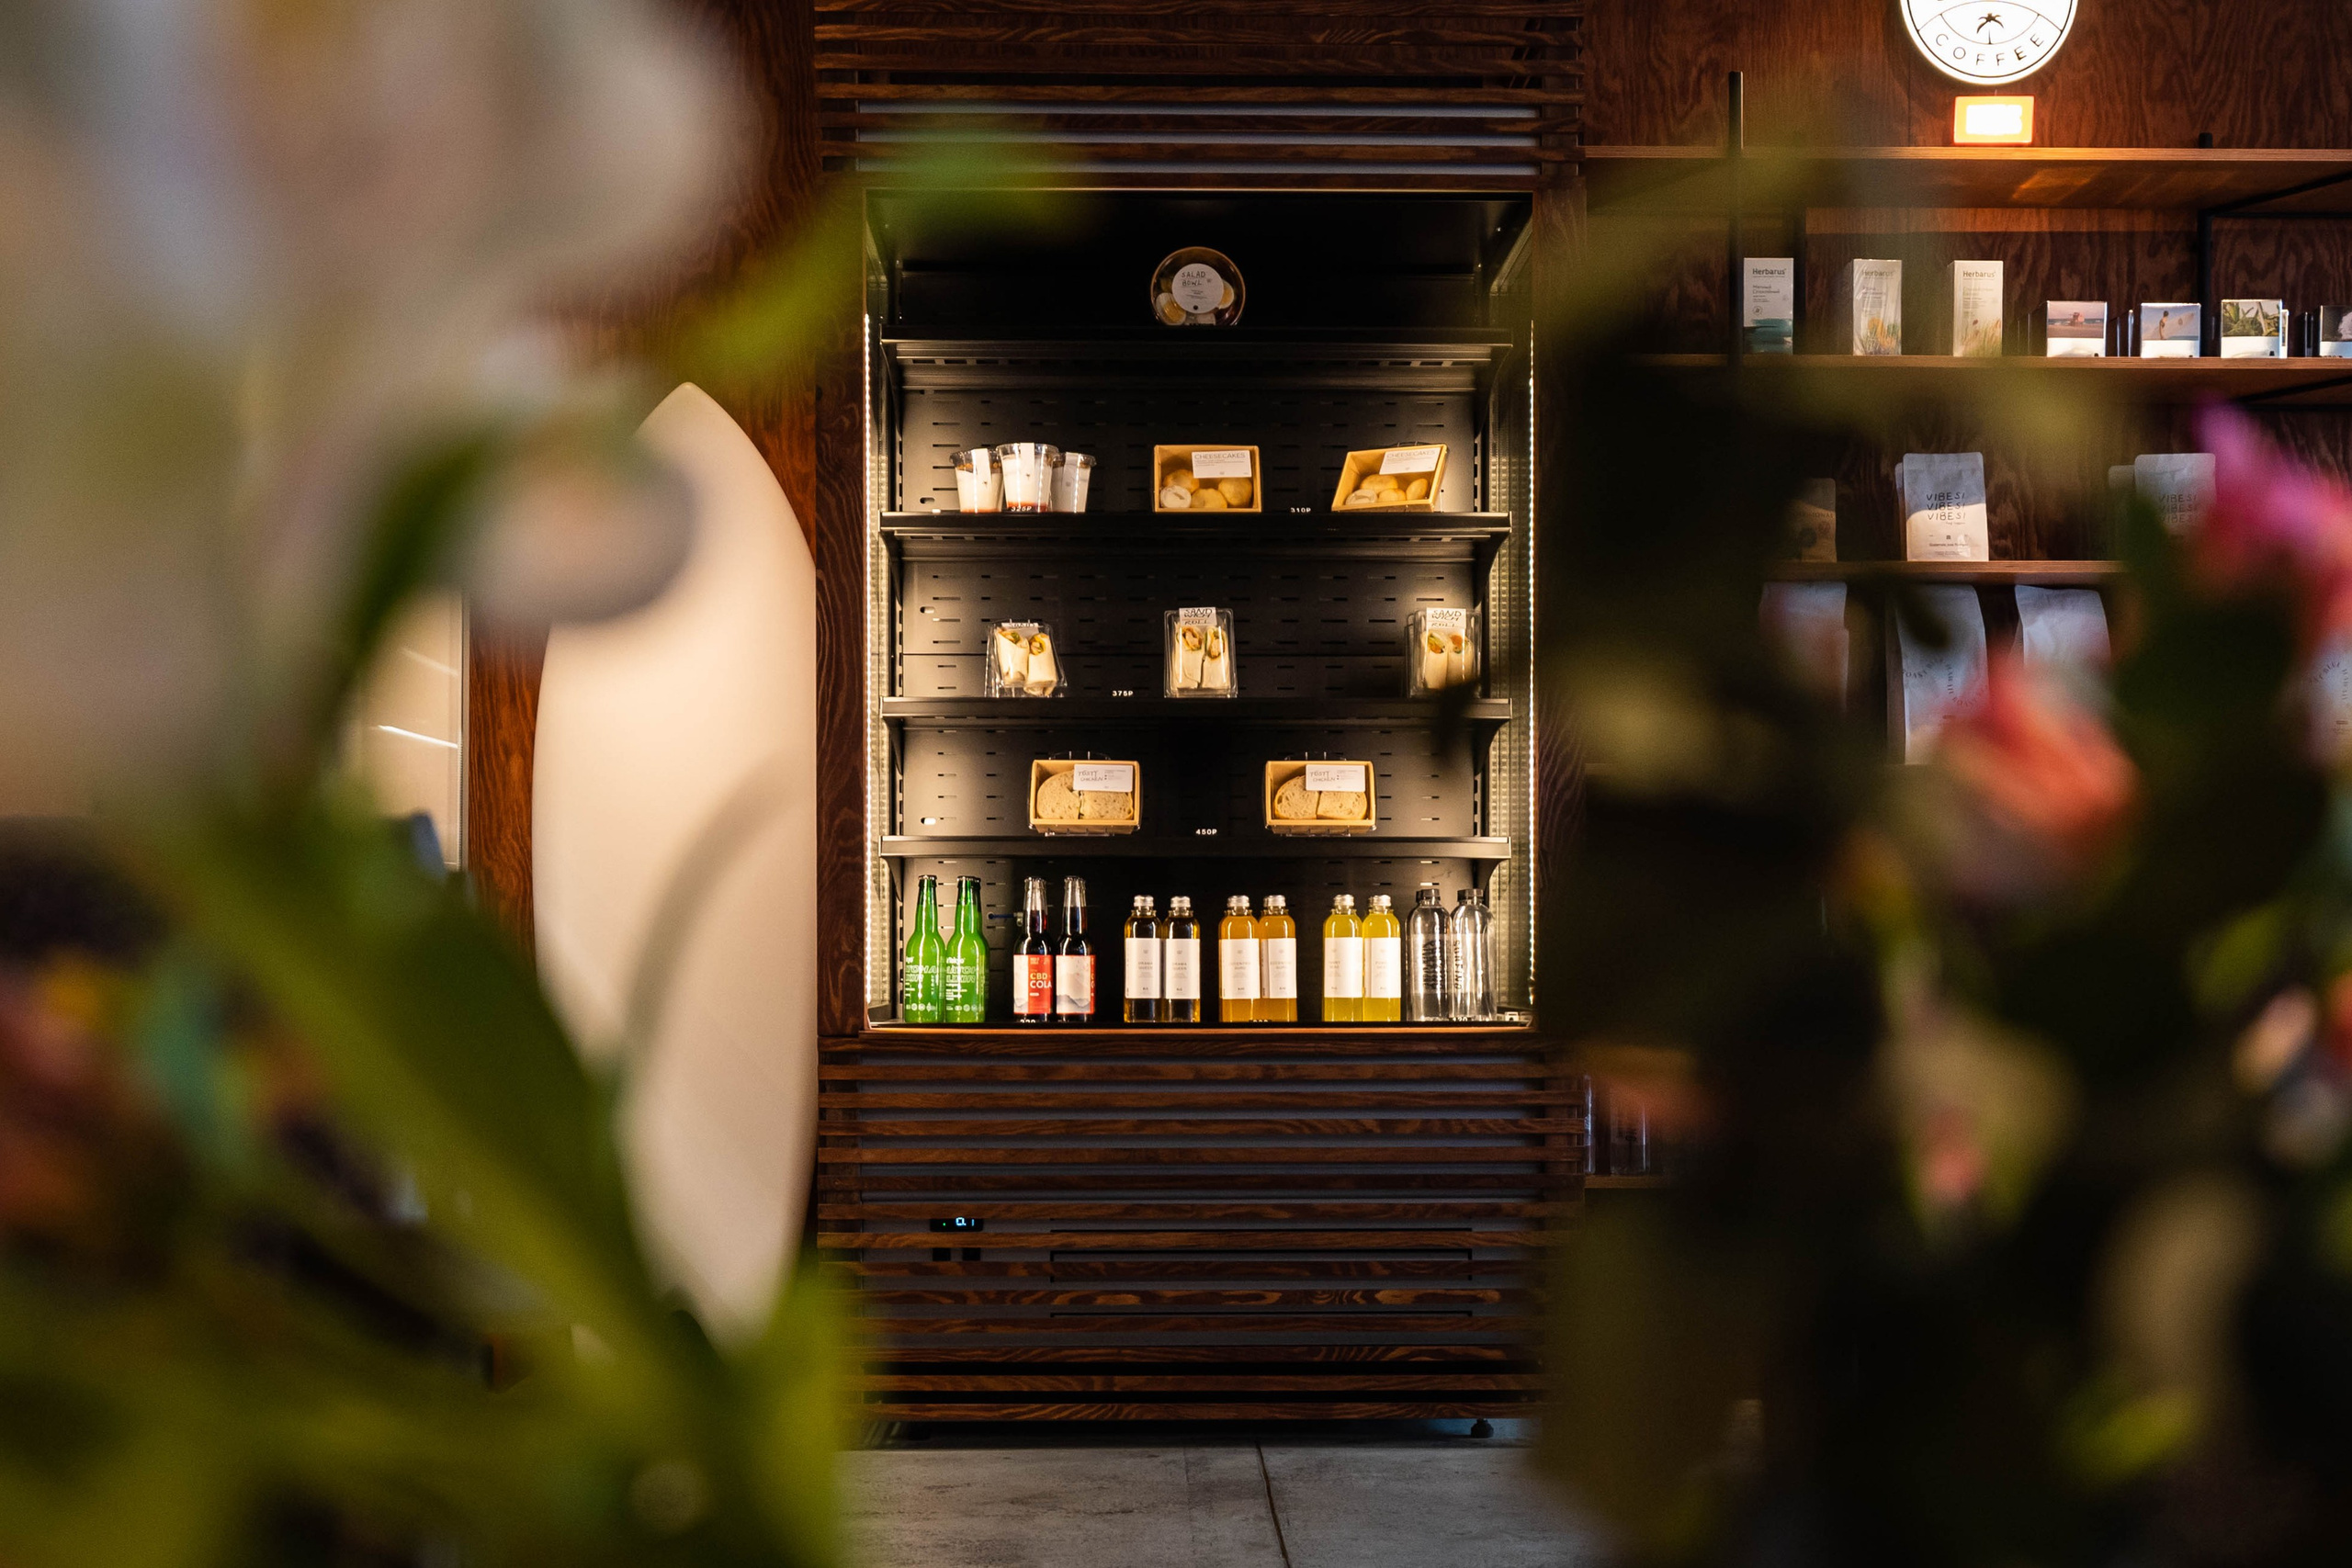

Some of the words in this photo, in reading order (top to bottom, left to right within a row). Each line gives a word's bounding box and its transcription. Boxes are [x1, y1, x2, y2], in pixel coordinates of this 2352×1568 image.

[1936, 33, 2044, 66] COFFEE
[1030, 972, 1048, 980] CBD
[1030, 980, 1053, 988] COLA
